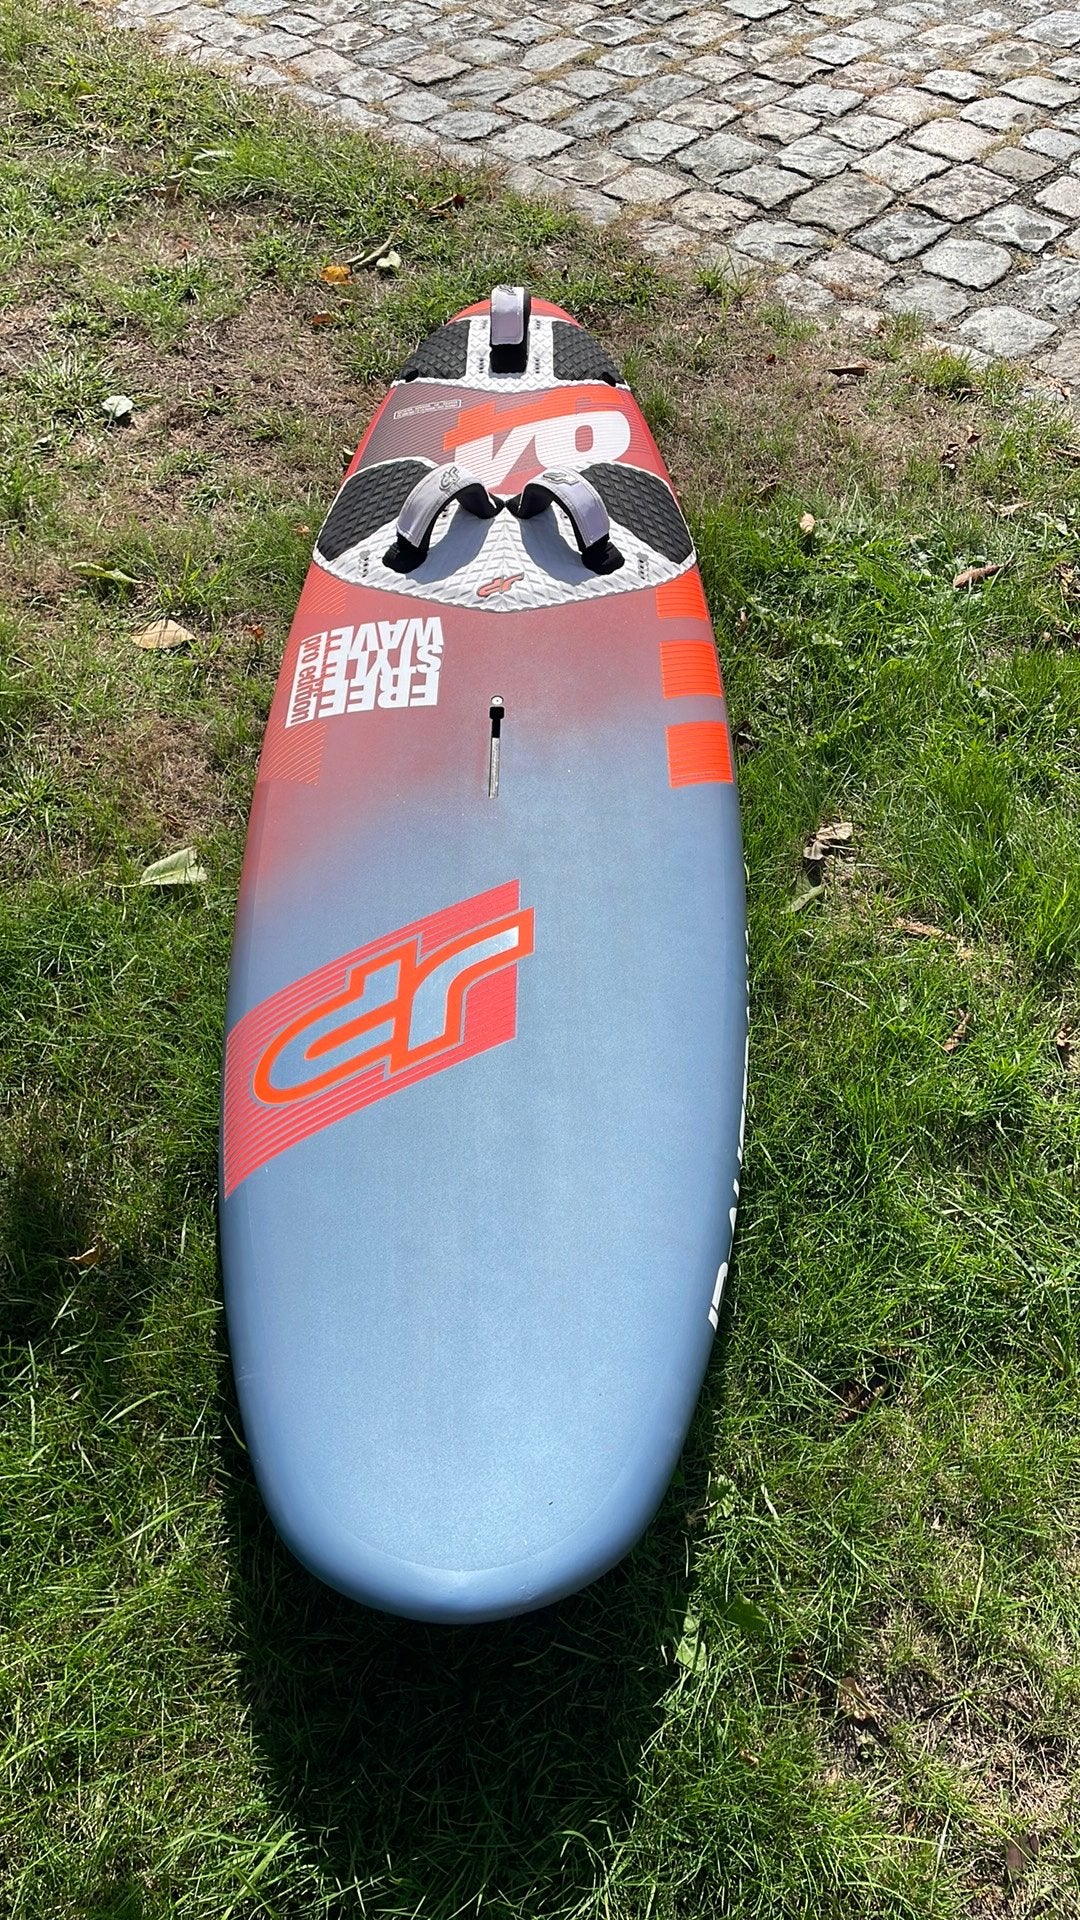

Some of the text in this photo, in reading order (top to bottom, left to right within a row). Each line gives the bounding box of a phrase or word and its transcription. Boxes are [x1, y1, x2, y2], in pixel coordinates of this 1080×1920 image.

[476, 573, 523, 598] JP
[330, 616, 444, 652] WAVE
[290, 635, 322, 726] pro edition
[323, 645, 442, 681] STYLE
[318, 670, 440, 718] FREE
[253, 908, 534, 1104] JP
